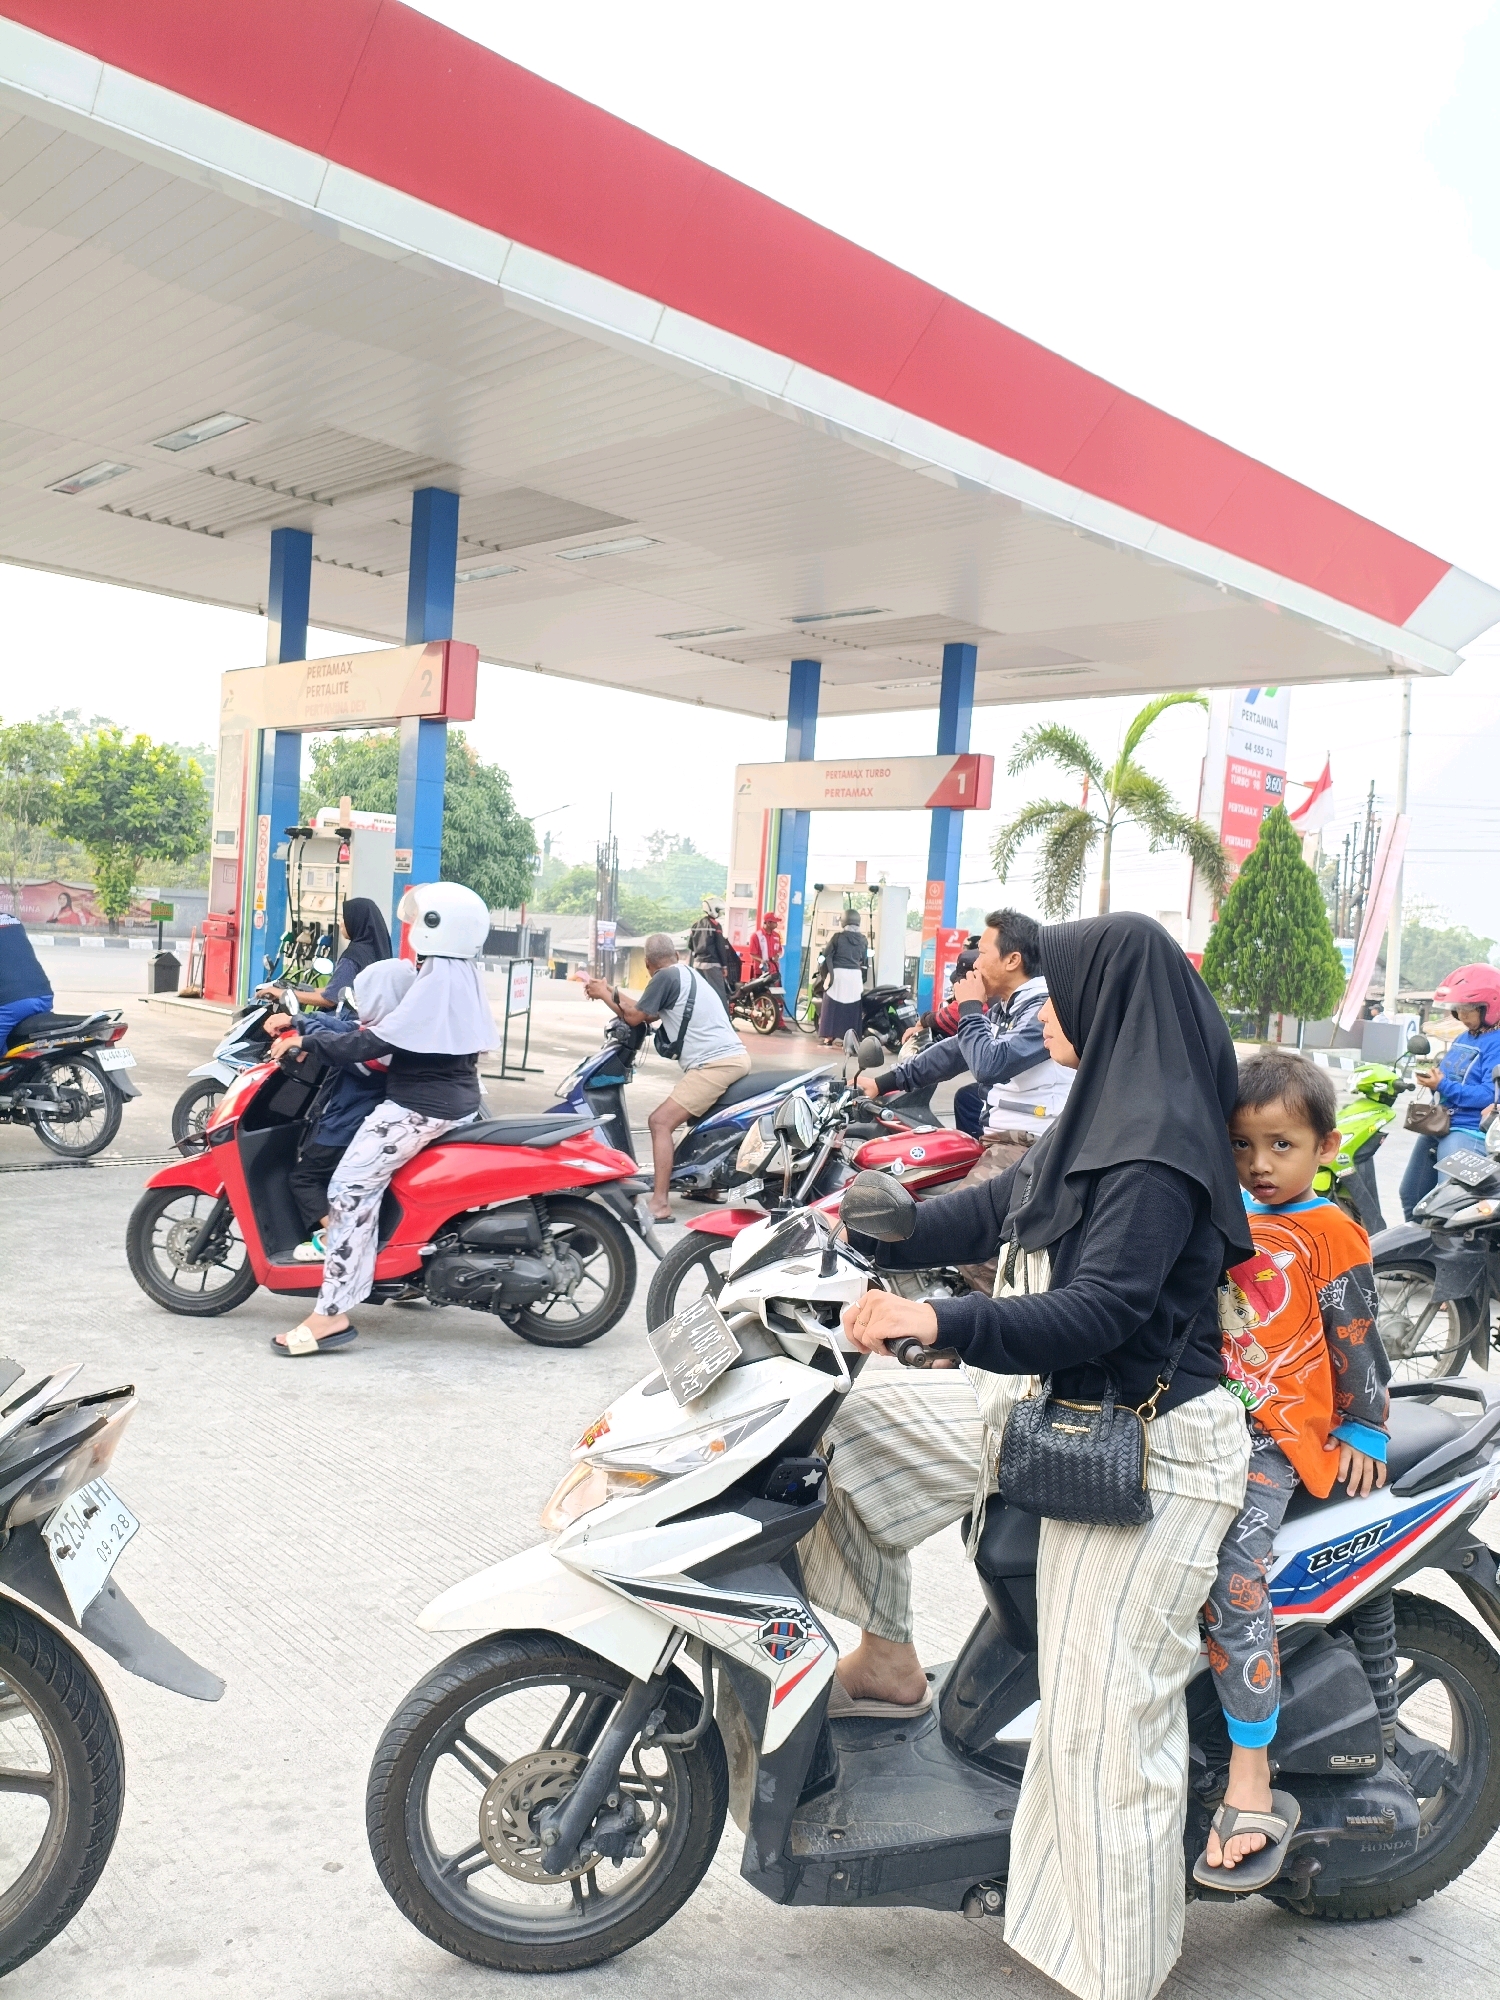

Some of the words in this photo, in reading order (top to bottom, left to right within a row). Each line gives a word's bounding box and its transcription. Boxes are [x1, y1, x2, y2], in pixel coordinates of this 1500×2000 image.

[306, 661, 353, 680] PERTAMAX
[305, 681, 349, 698] PERTALITE
[420, 669, 432, 697] 2
[1241, 709, 1279, 730] PERTAMINA
[1244, 742, 1253, 753] 44
[825, 769, 863, 780] PERTAMAX
[865, 768, 891, 779] TURBO
[1231, 763, 1262, 780] PERTAMAX
[957, 773, 966, 794] 1
[1230, 774, 1250, 789] TURBO
[824, 788, 873, 798] PERTAMAX
[1228, 802, 1258, 817] PERTAMAX
[1224, 834, 1253, 849] PERTALITE
[679, 1300, 707, 1327] AB
[688, 1319, 726, 1355] 4183
[54, 1504, 92, 1560] 2254
[1359, 1839, 1414, 1853] HONDA
